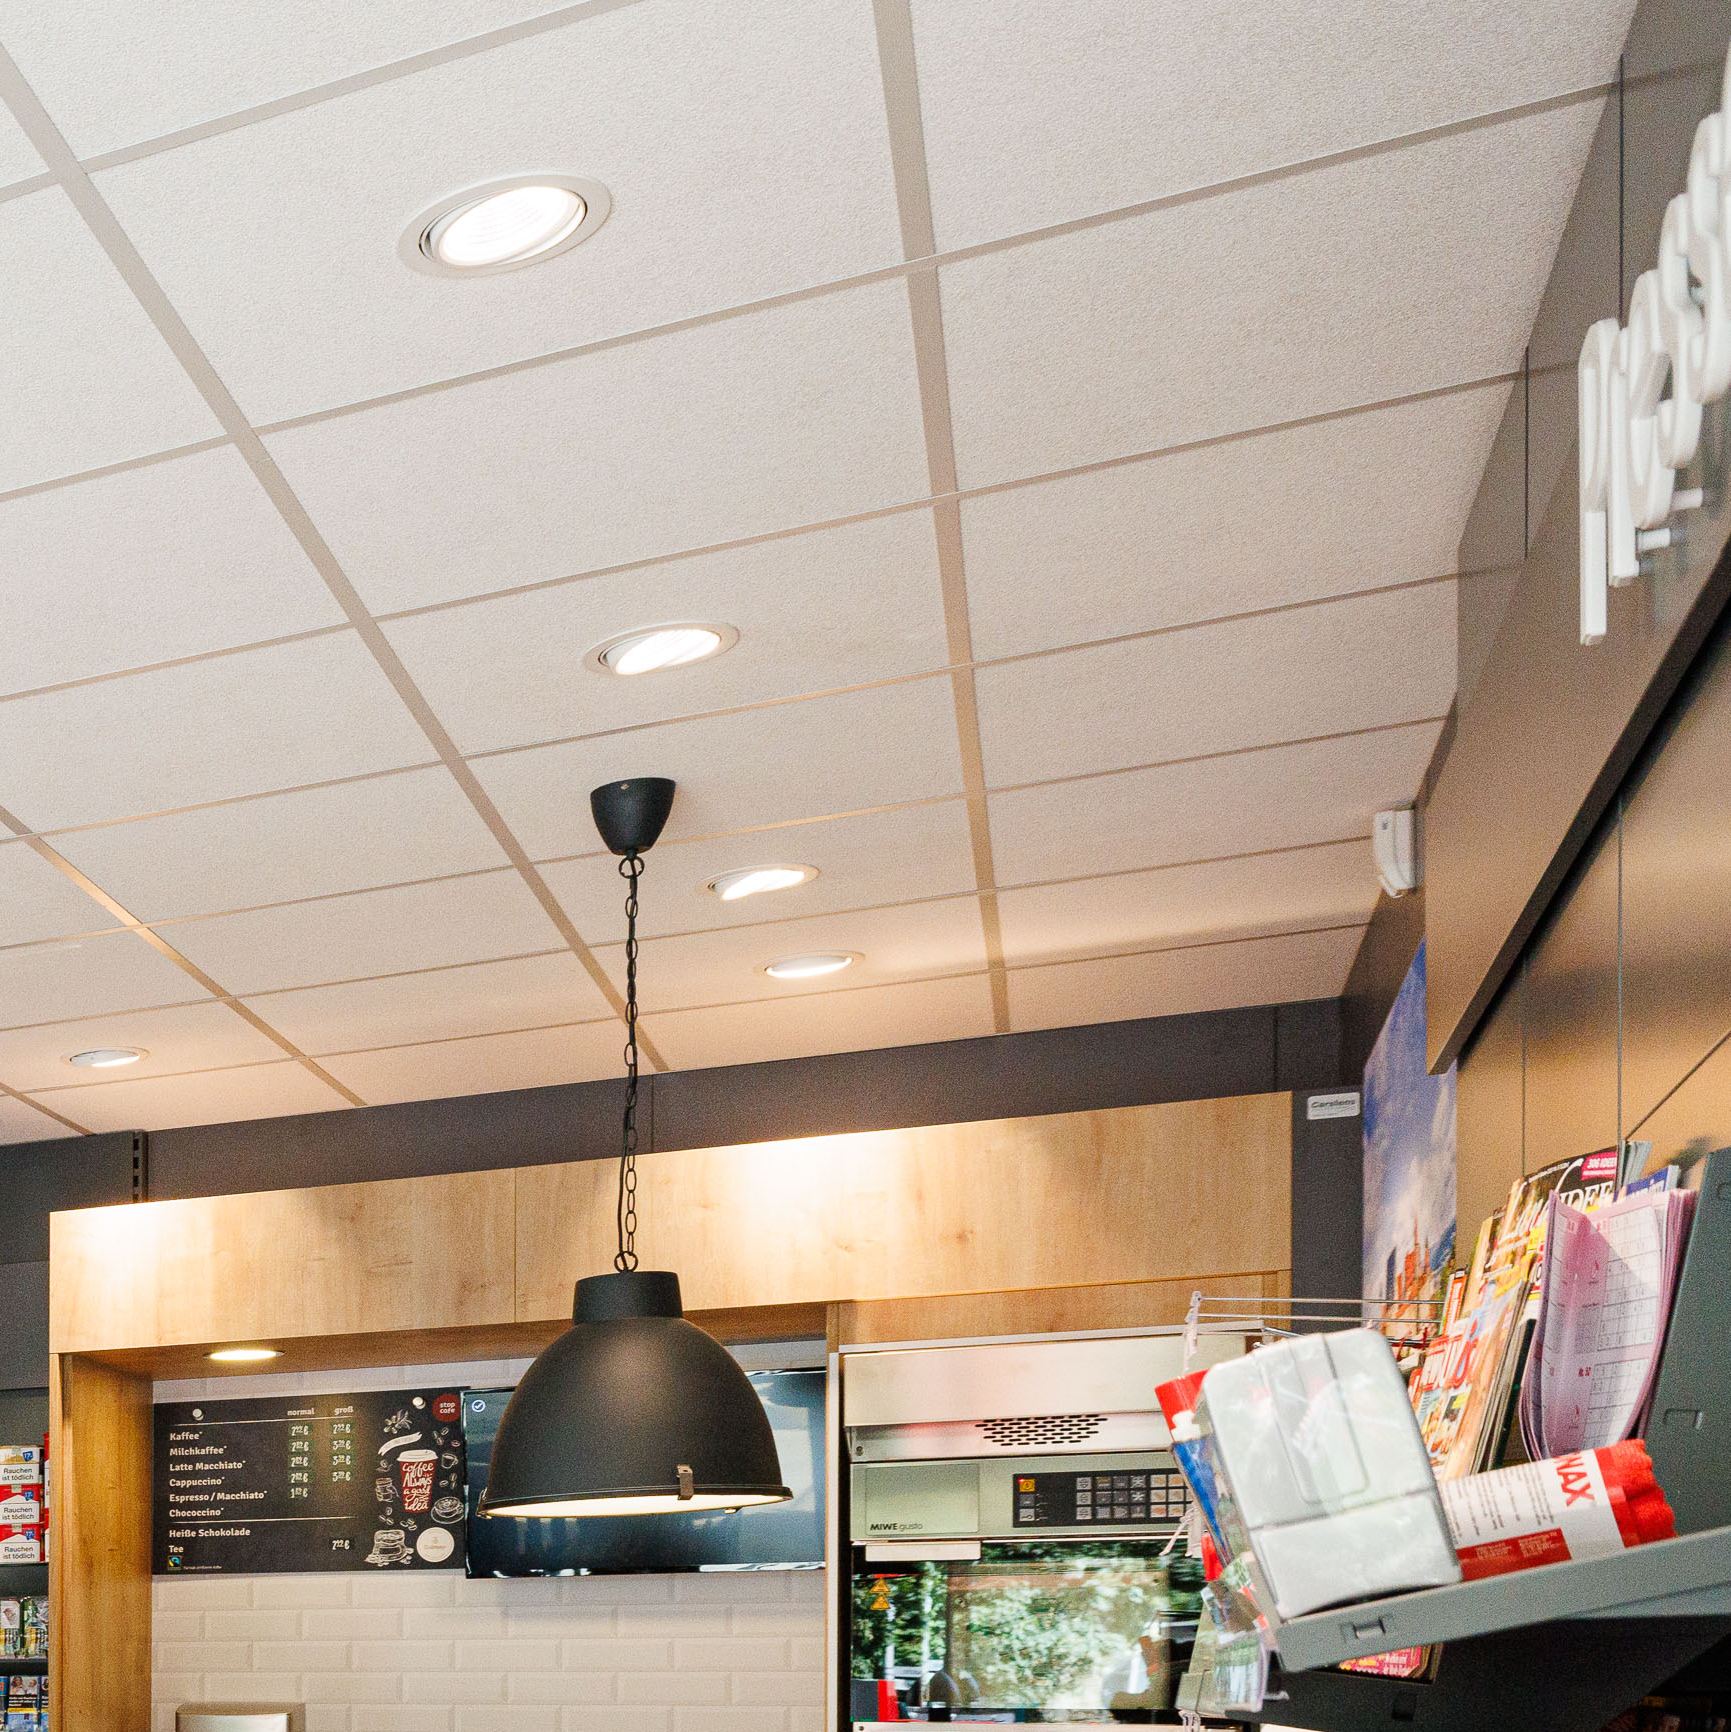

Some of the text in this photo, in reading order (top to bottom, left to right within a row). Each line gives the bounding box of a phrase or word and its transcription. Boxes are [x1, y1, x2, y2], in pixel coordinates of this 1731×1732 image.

[287, 1406, 354, 1416] normal groß
[3, 1467, 34, 1475] Rauchen
[170, 1463, 194, 1471] Latte
[11, 1473, 35, 1481] tödlich
[170, 1494, 209, 1503] Espresso
[3, 1507, 34, 1515] Rauchen
[11, 1513, 35, 1521] tödlich
[870, 1523, 923, 1533] MIWE gusto
[169, 1528, 251, 1538] Heiße Schokolade
[4, 1546, 35, 1554] Rauchen
[168, 1545, 184, 1553] Tee
[12, 1552, 36, 1560] tödlich
